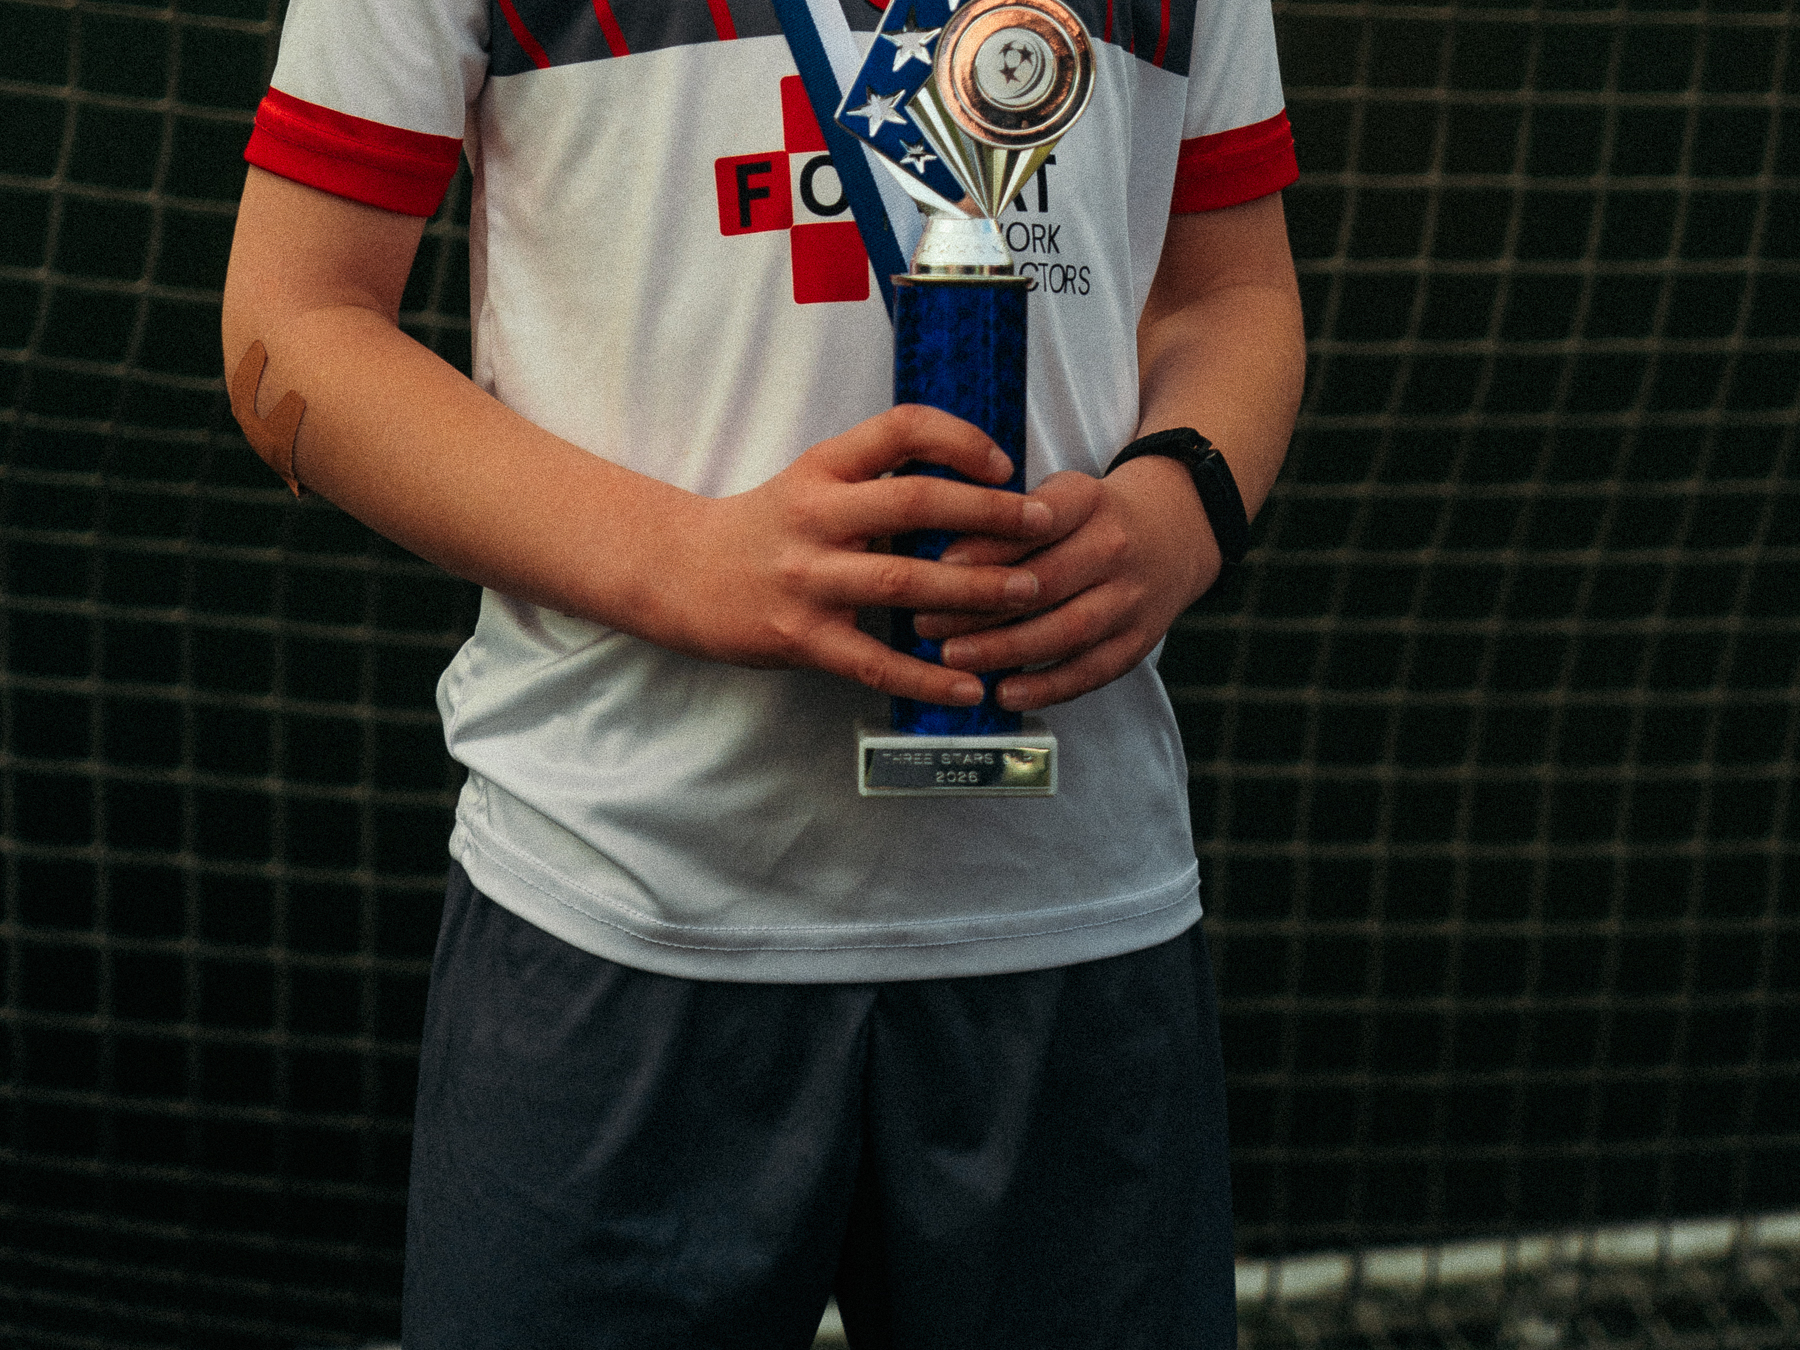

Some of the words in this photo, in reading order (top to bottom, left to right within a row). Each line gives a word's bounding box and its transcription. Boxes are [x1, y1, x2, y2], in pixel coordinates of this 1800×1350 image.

[882, 752, 934, 766] THREE
[940, 752, 995, 766] STARS
[935, 770, 979, 783] 2026
